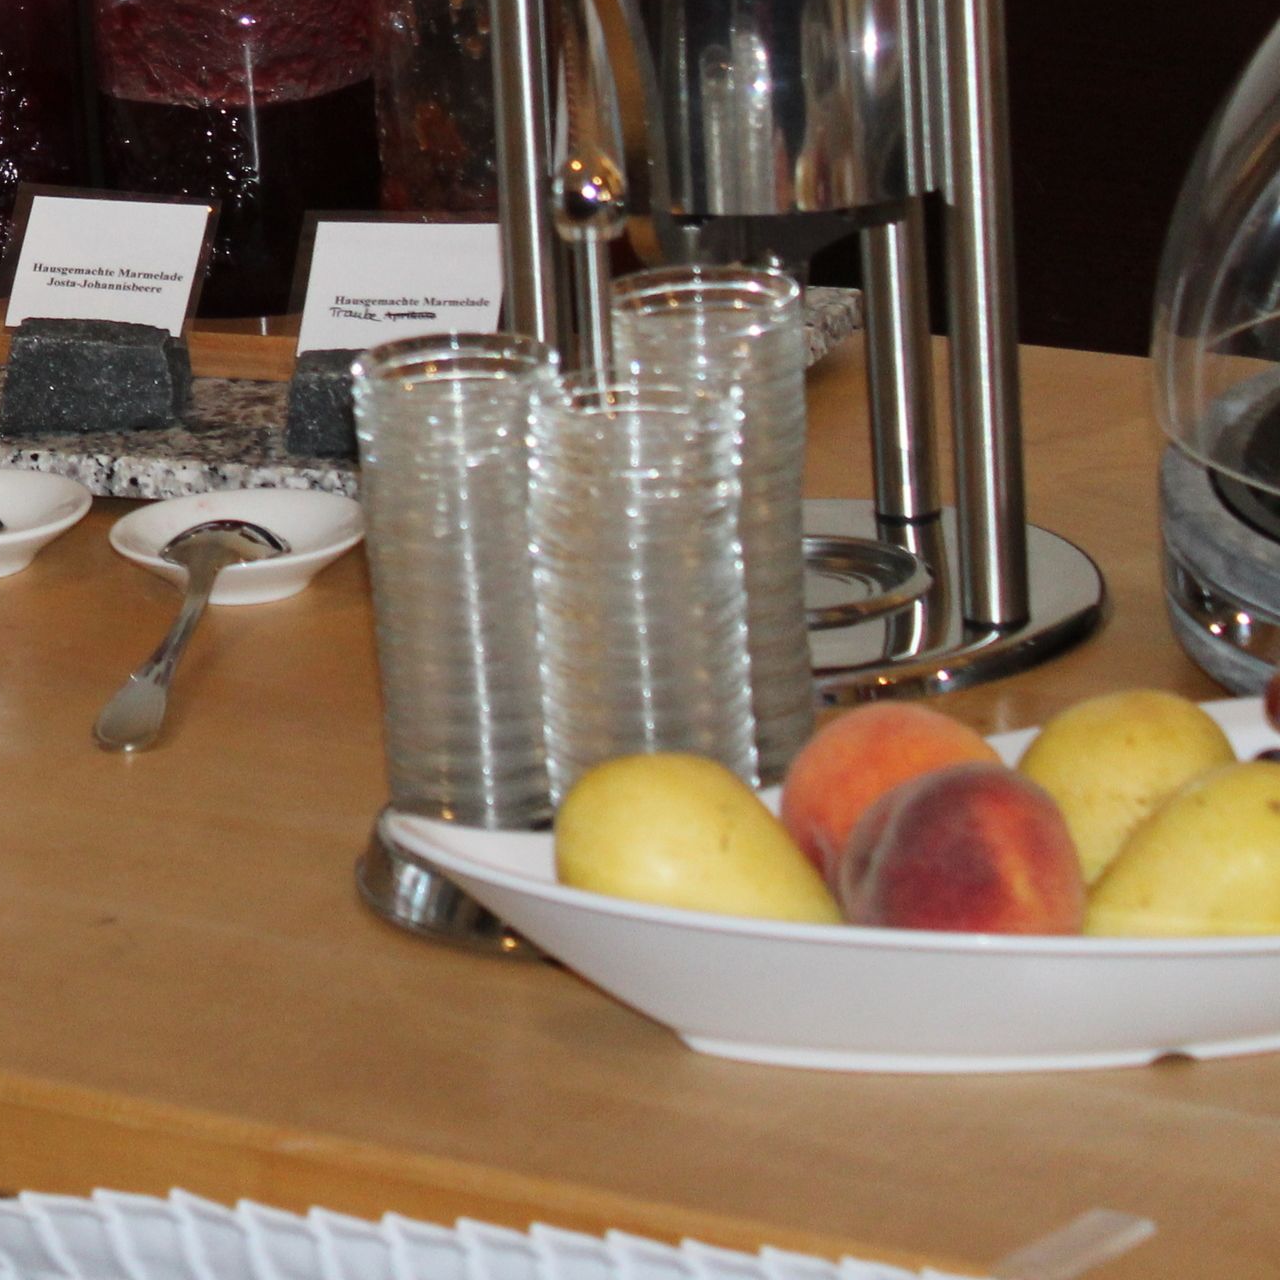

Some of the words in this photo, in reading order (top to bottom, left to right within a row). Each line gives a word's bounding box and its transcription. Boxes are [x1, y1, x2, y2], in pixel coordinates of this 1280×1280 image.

[33, 263, 116, 277] Hausgemachte
[118, 268, 184, 282] Marmelade
[47, 277, 163, 294] Josta-Johannisbeere
[335, 296, 420, 307] Hausgemachte
[423, 297, 490, 307] Marmelade
